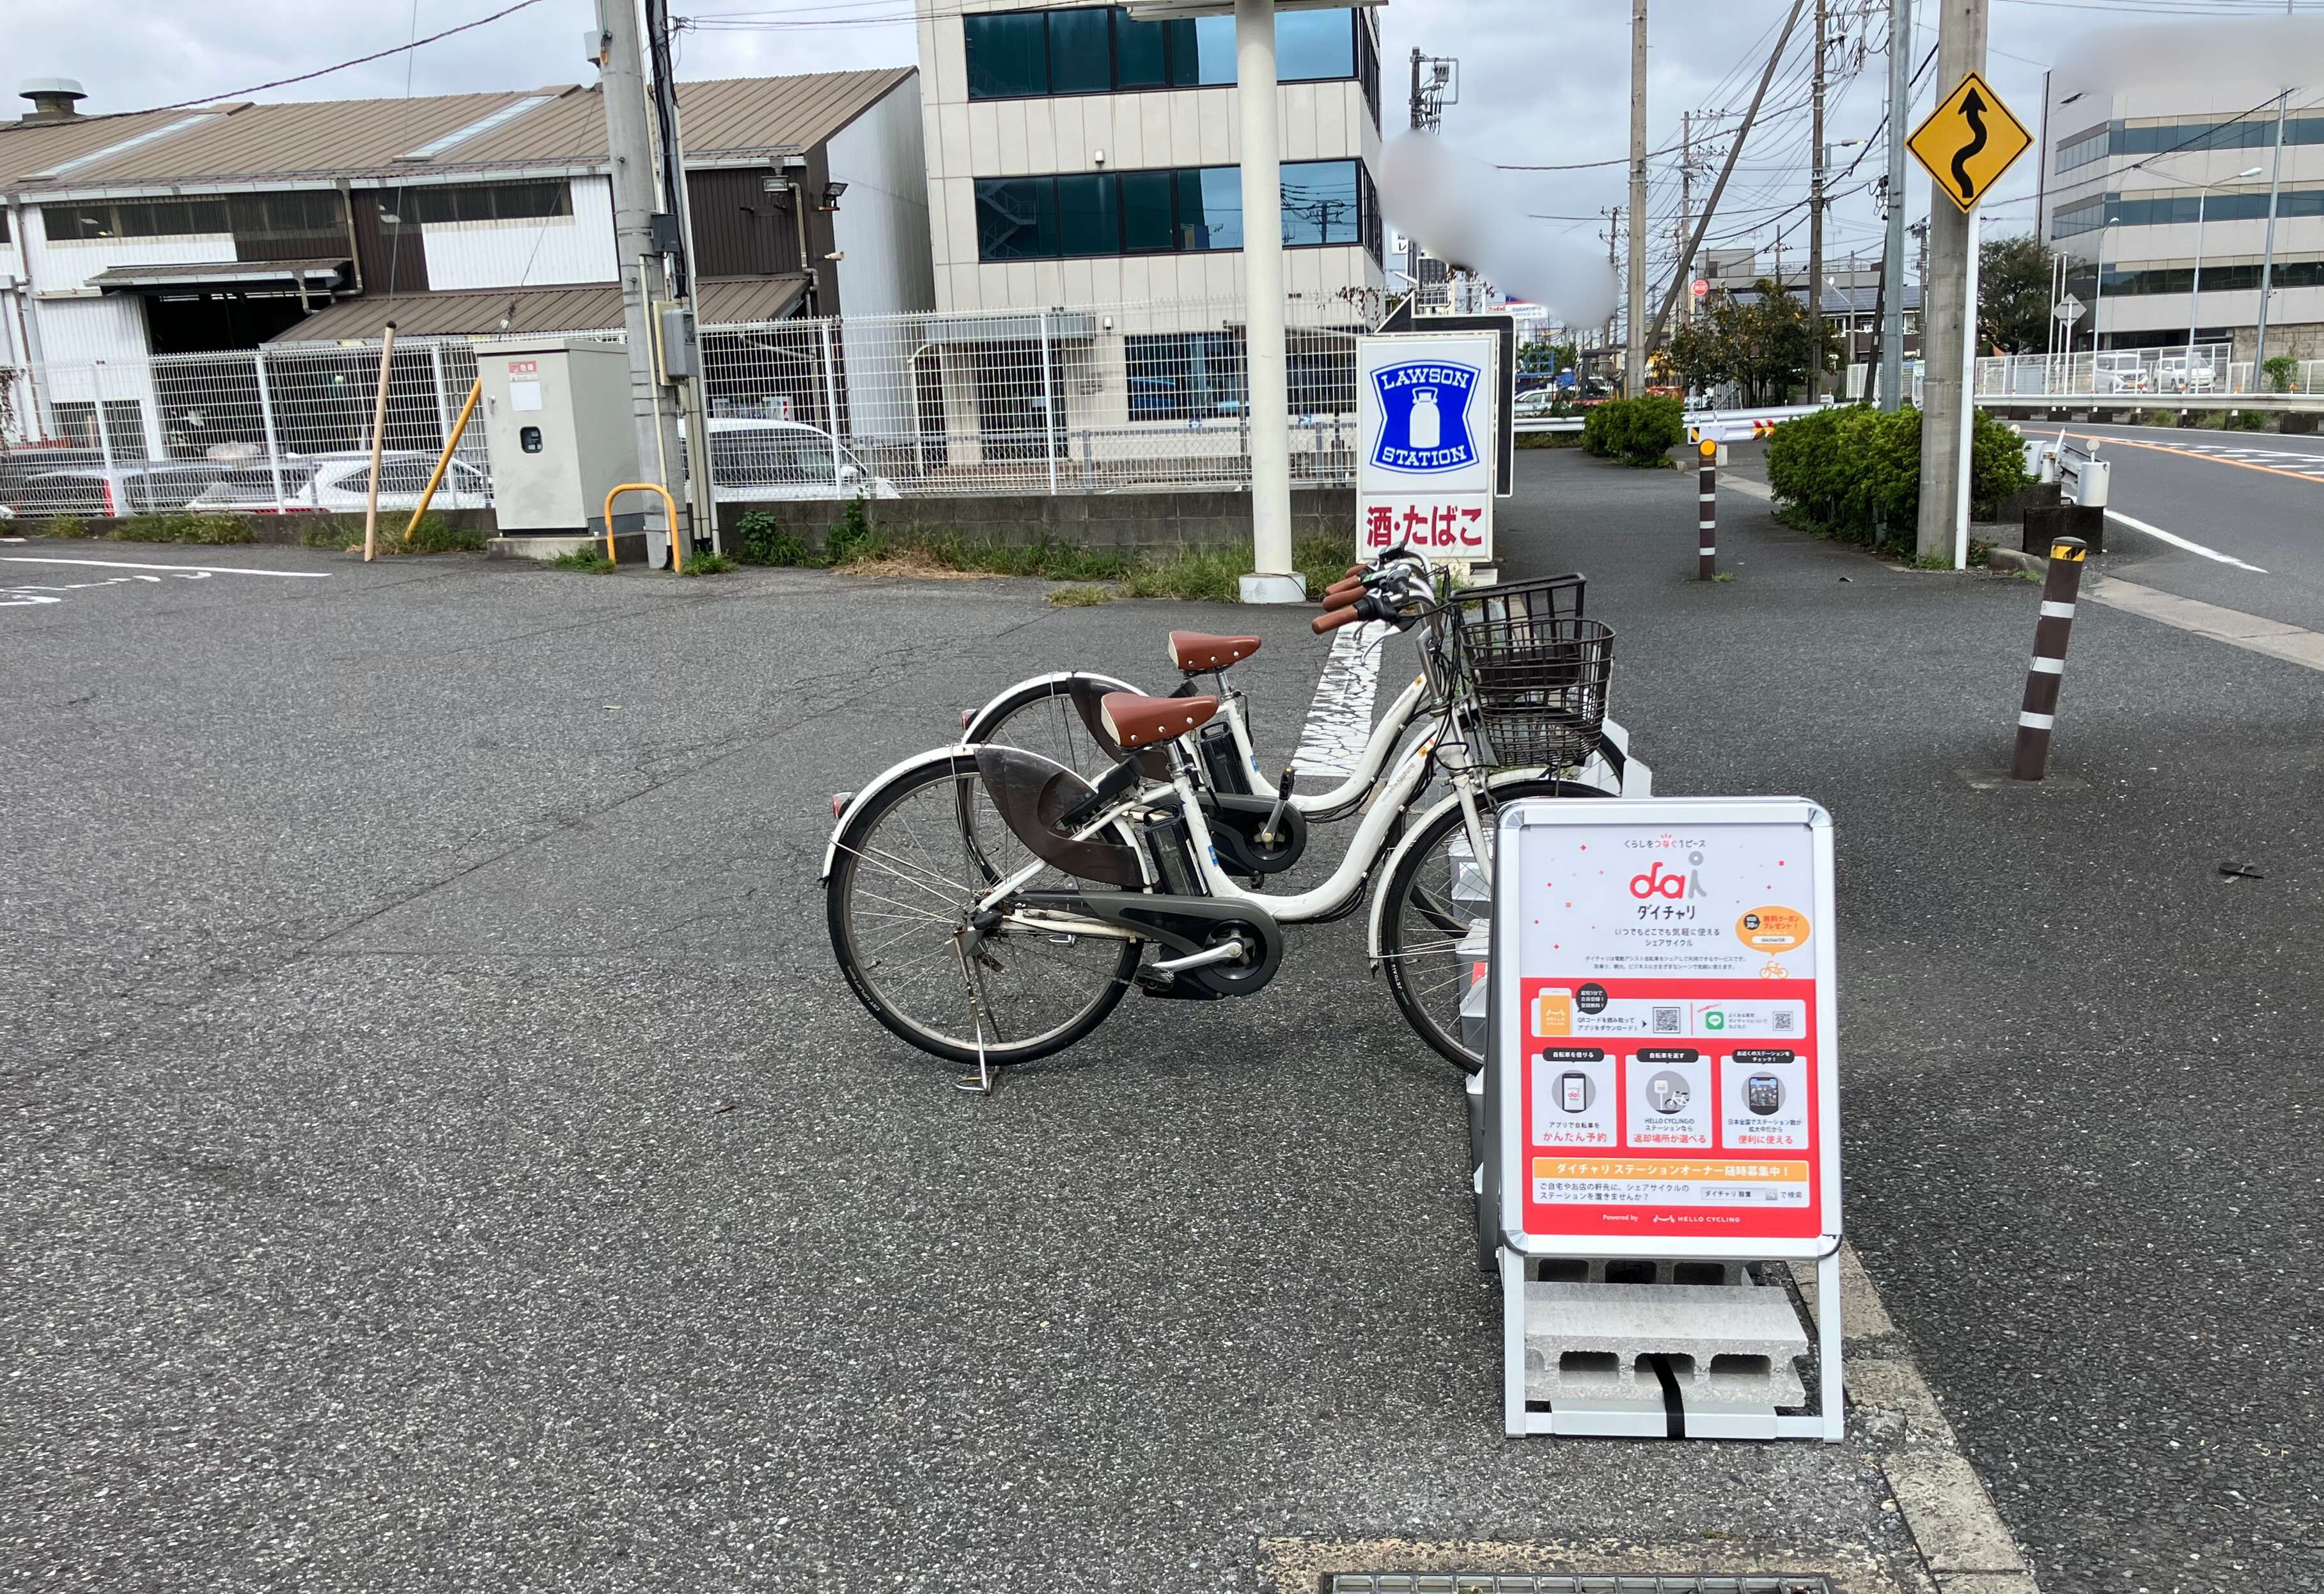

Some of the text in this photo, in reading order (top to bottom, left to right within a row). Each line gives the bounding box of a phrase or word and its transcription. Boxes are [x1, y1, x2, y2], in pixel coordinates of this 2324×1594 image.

[1381, 368, 1469, 390] LAWSON
[1382, 445, 1467, 466] STATION
[1366, 505, 1483, 547] 酒・たばこ
[1630, 850, 1707, 899] dai
[1638, 905, 1696, 919] ダイチャリ
[1543, 1132, 1607, 1143] かんたん予約
[1634, 1134, 1706, 1143] 返却場所が選べる
[1738, 1136, 1793, 1145] 便利に使える
[1540, 1183, 1689, 1192] ご自宅やお店の軒先に、シェアサイクルの
[1540, 1192, 1648, 1200] ステーションを置きませんか？
